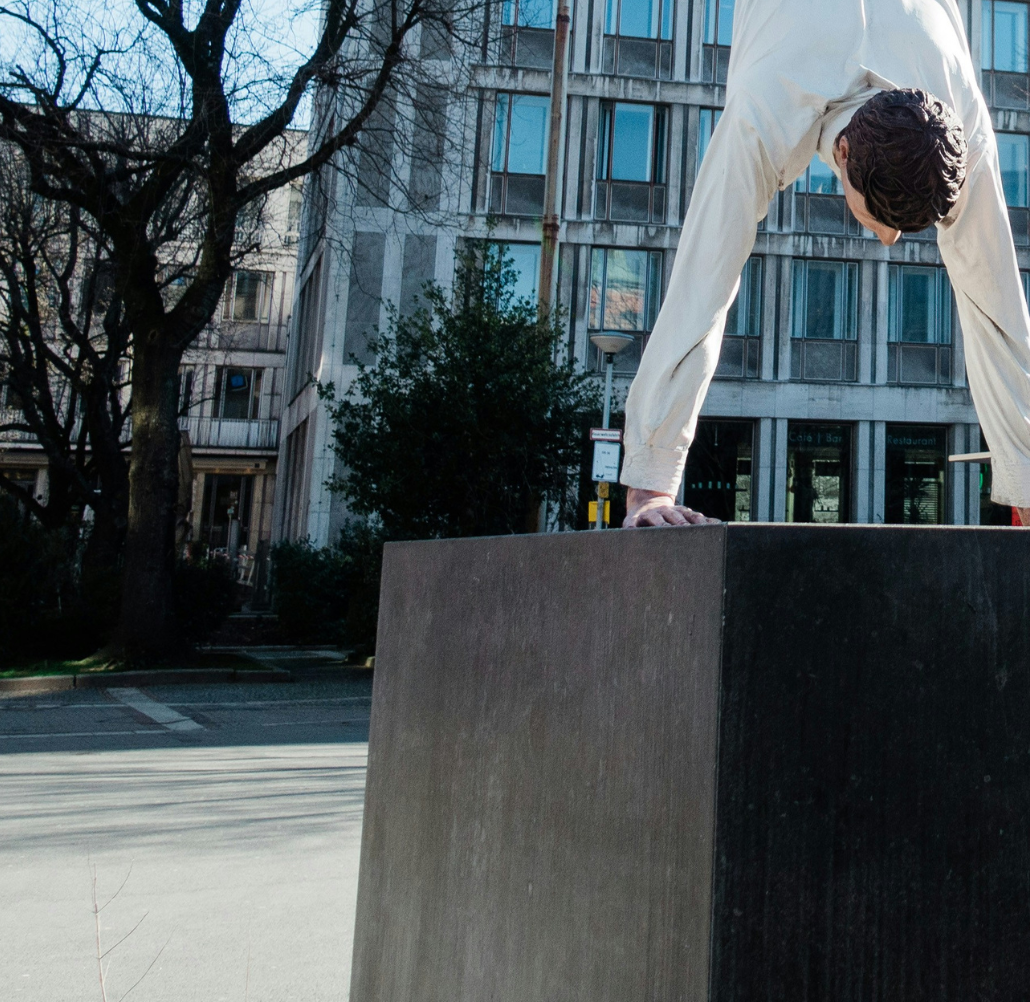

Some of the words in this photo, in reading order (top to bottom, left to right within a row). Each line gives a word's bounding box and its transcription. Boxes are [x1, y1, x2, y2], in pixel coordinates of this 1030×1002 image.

[788, 430, 813, 443] Café
[826, 432, 842, 444] Bar
[886, 435, 937, 446] Restaurant
